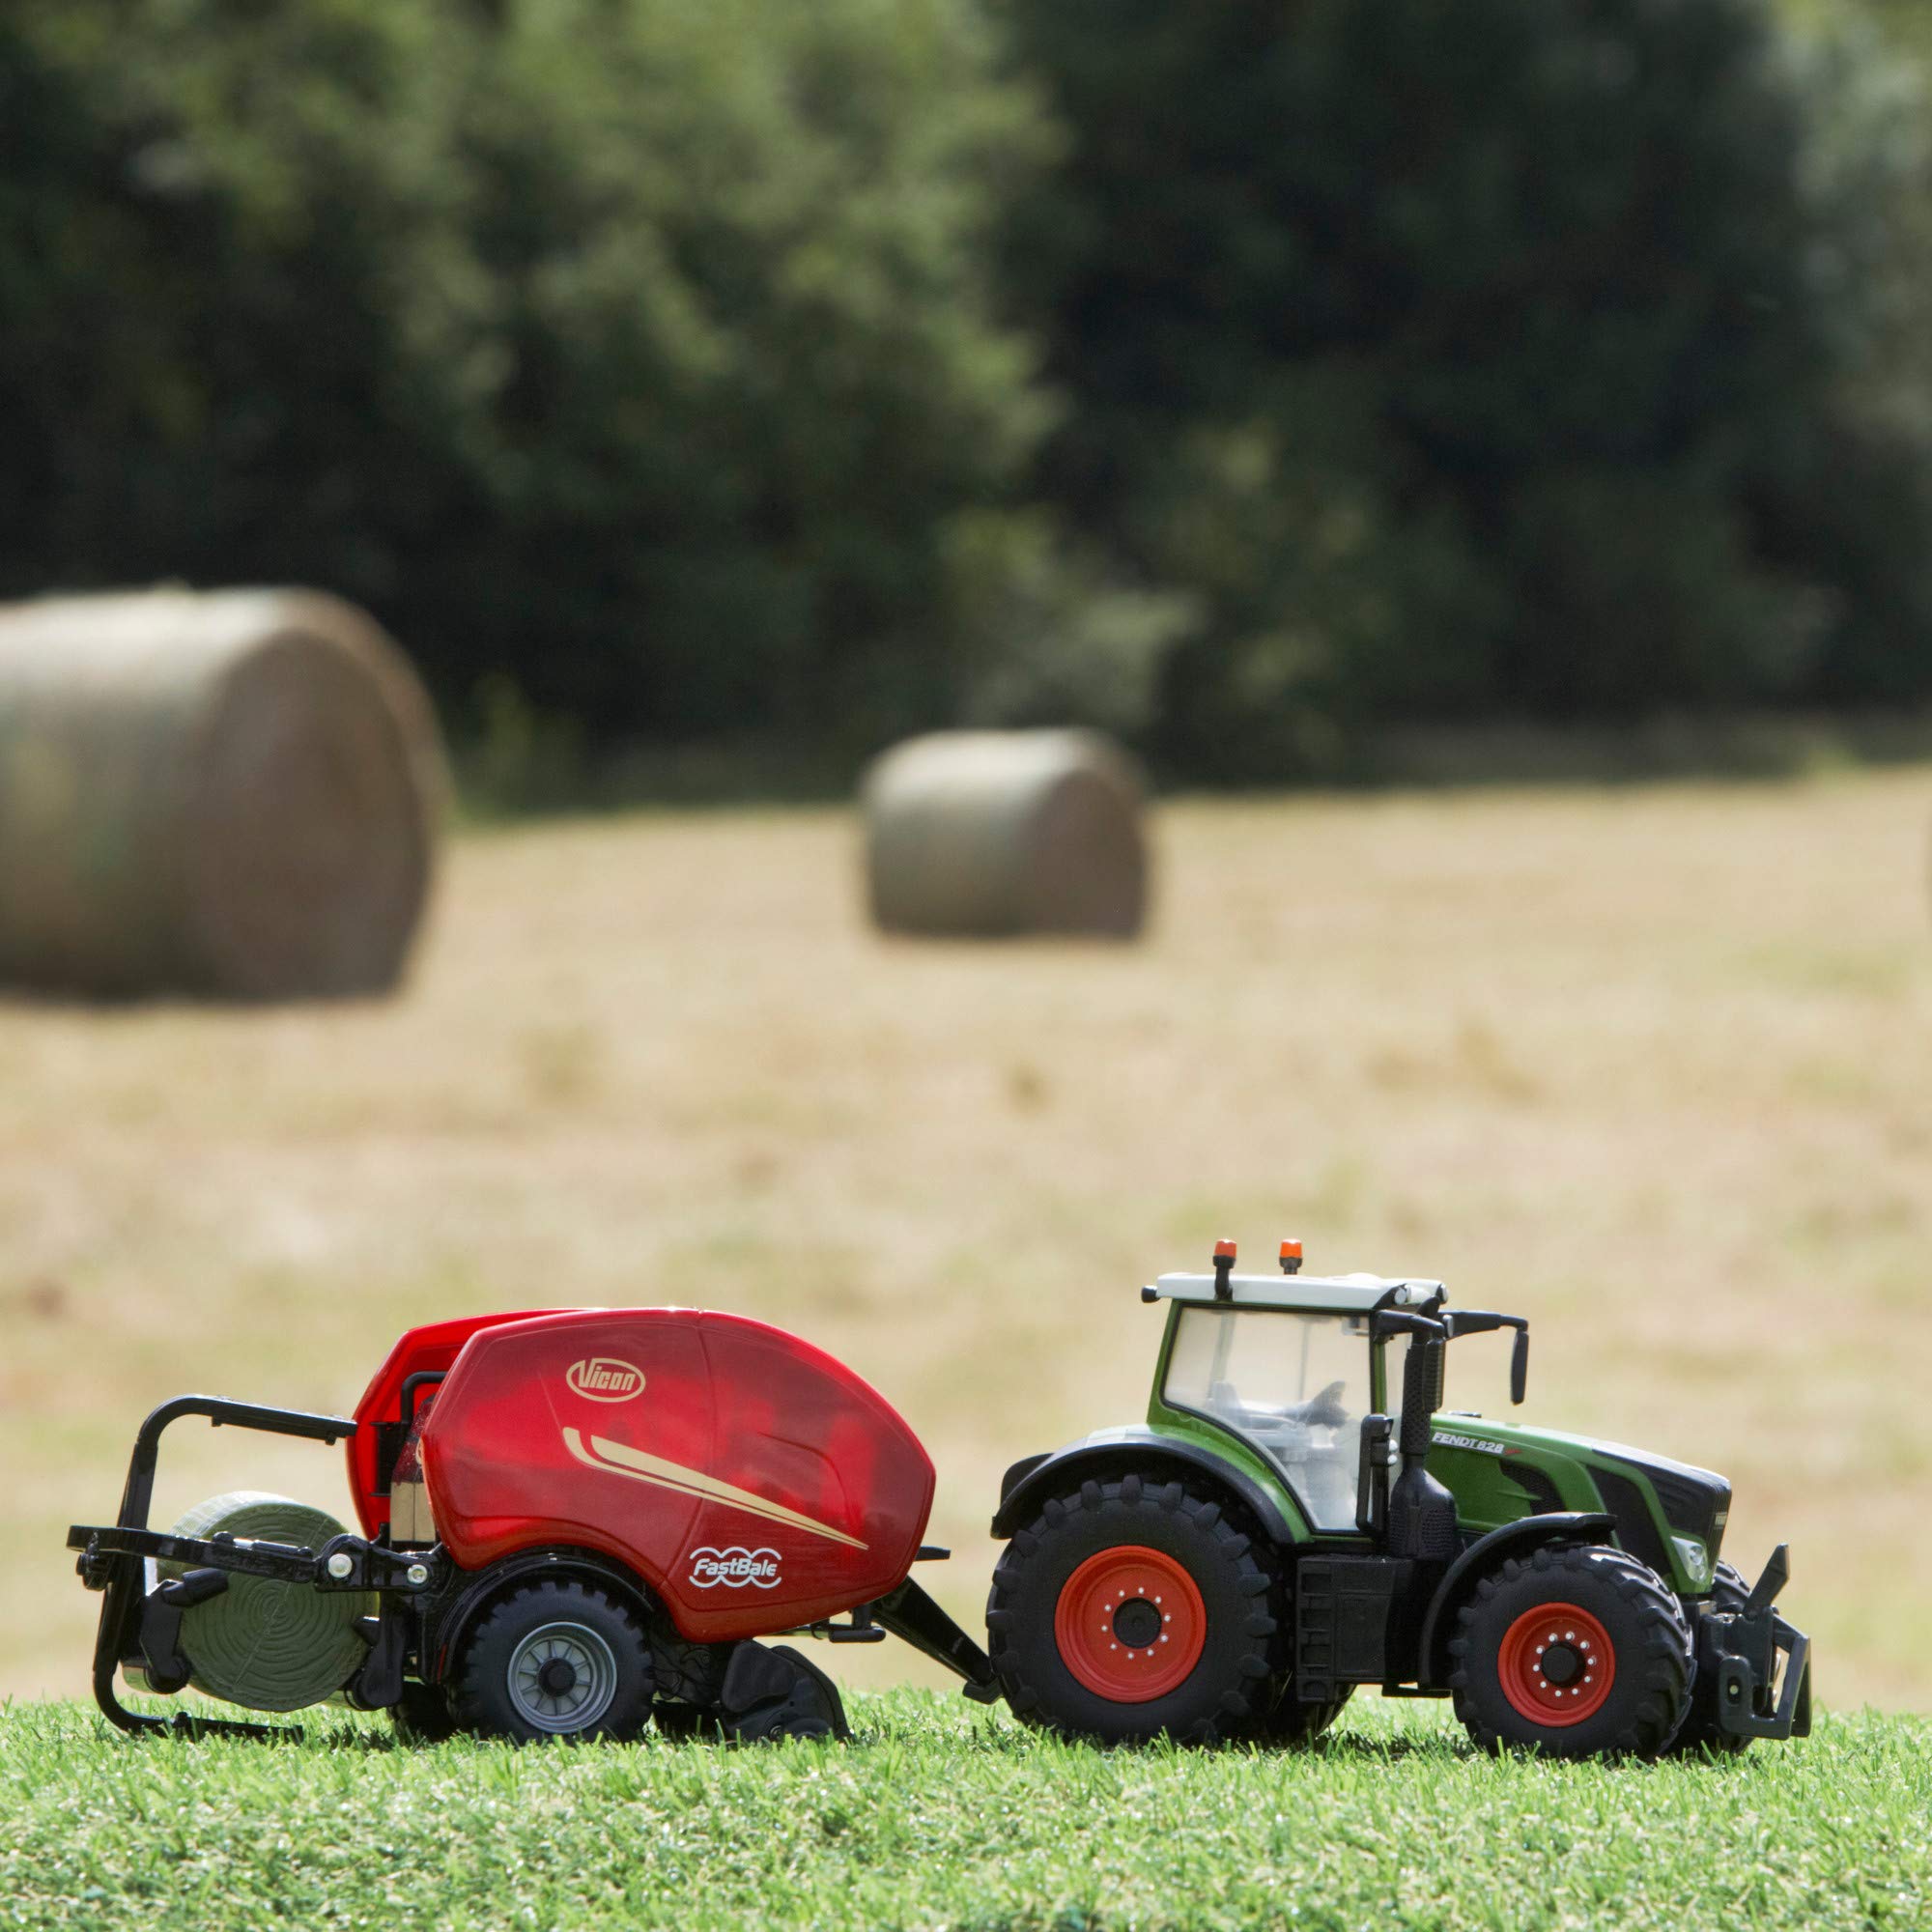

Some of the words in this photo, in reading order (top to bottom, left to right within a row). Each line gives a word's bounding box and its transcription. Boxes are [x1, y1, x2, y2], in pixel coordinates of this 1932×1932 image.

[579, 1358, 637, 1391] Vicon
[1432, 1432, 1478, 1448] FENDT
[1476, 1440, 1505, 1454] 828
[694, 1557, 778, 1577] FastBale
